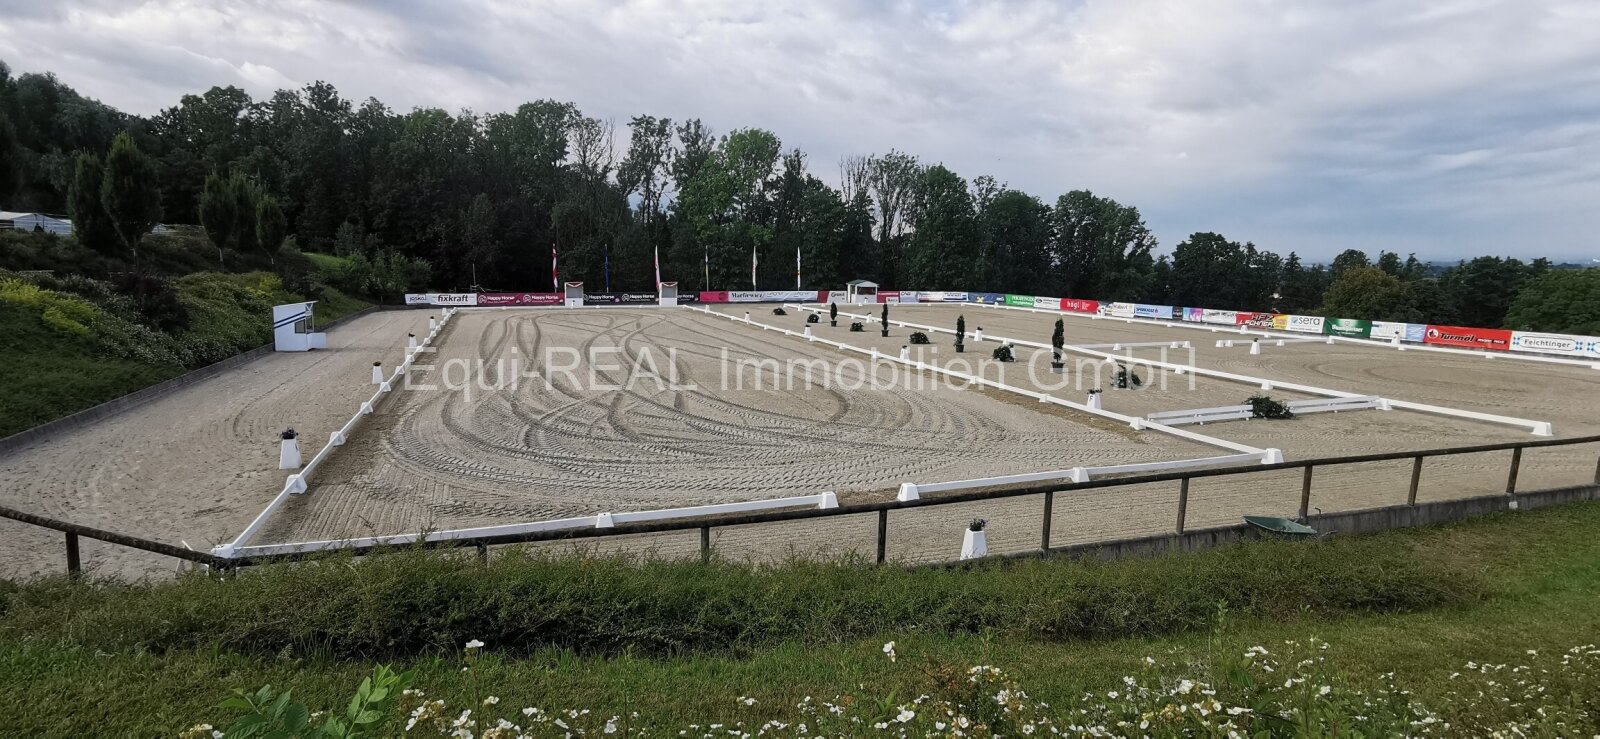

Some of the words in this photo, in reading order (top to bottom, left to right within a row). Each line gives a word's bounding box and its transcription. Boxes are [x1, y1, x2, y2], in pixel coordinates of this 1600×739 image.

[437, 294, 468, 302] fixkraft
[1298, 316, 1320, 325] sera
[1524, 339, 1571, 348] Feichtinger
